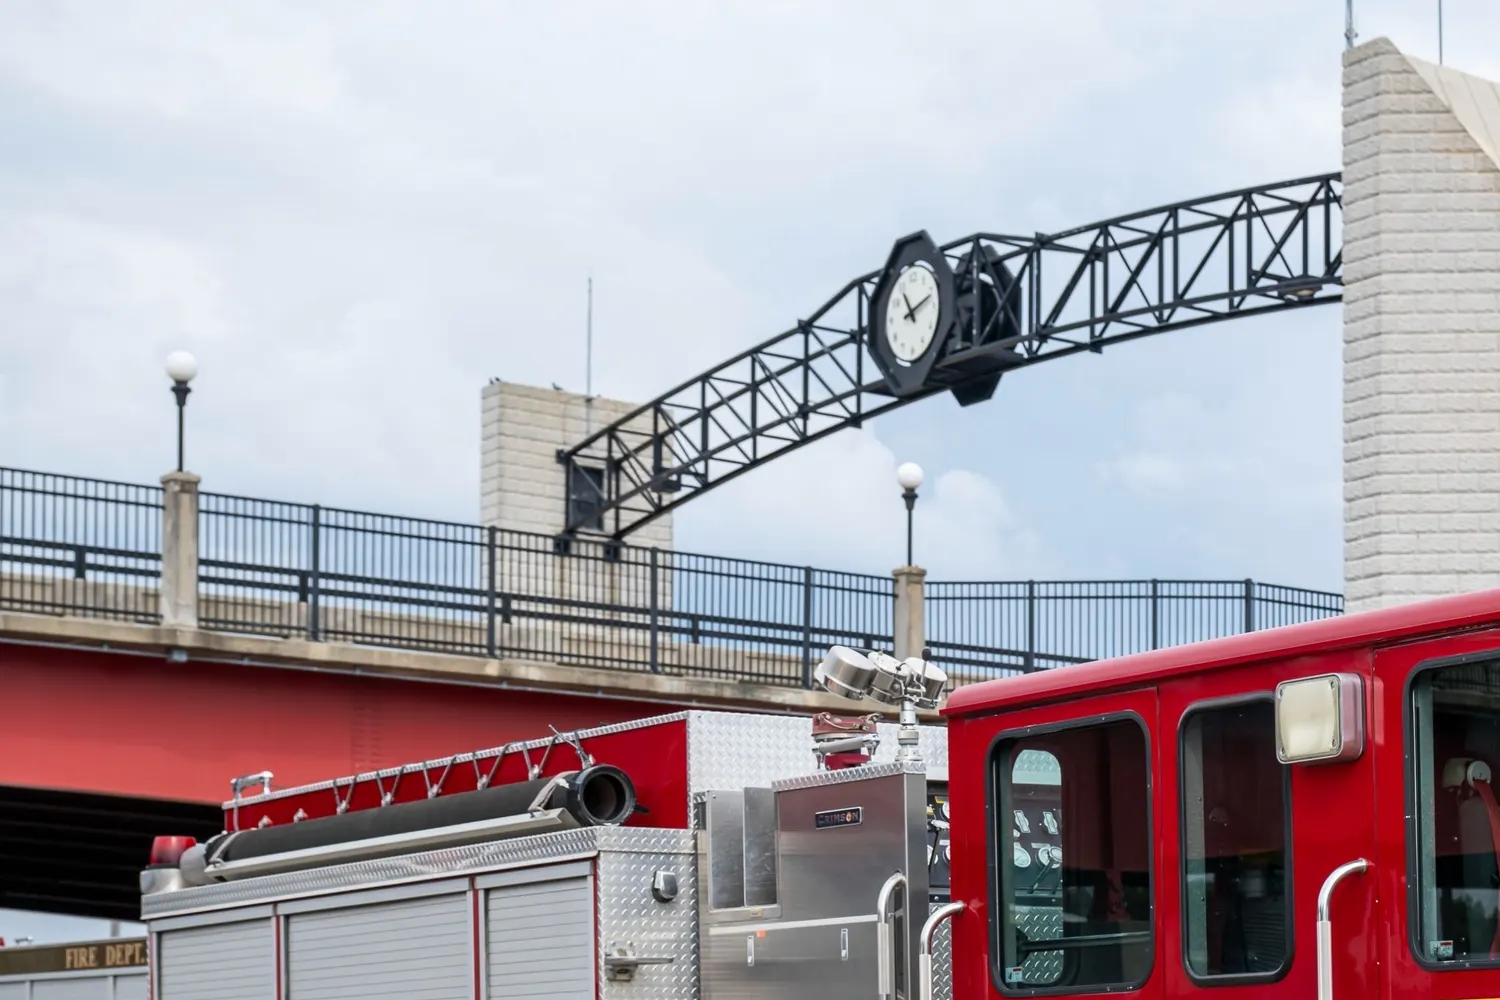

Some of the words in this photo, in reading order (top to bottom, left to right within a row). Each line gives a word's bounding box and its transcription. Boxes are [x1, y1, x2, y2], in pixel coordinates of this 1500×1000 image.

[818, 811, 859, 825] CRIMSON
[65, 946, 98, 969] FIRE
[105, 942, 146, 966] DEPT.
